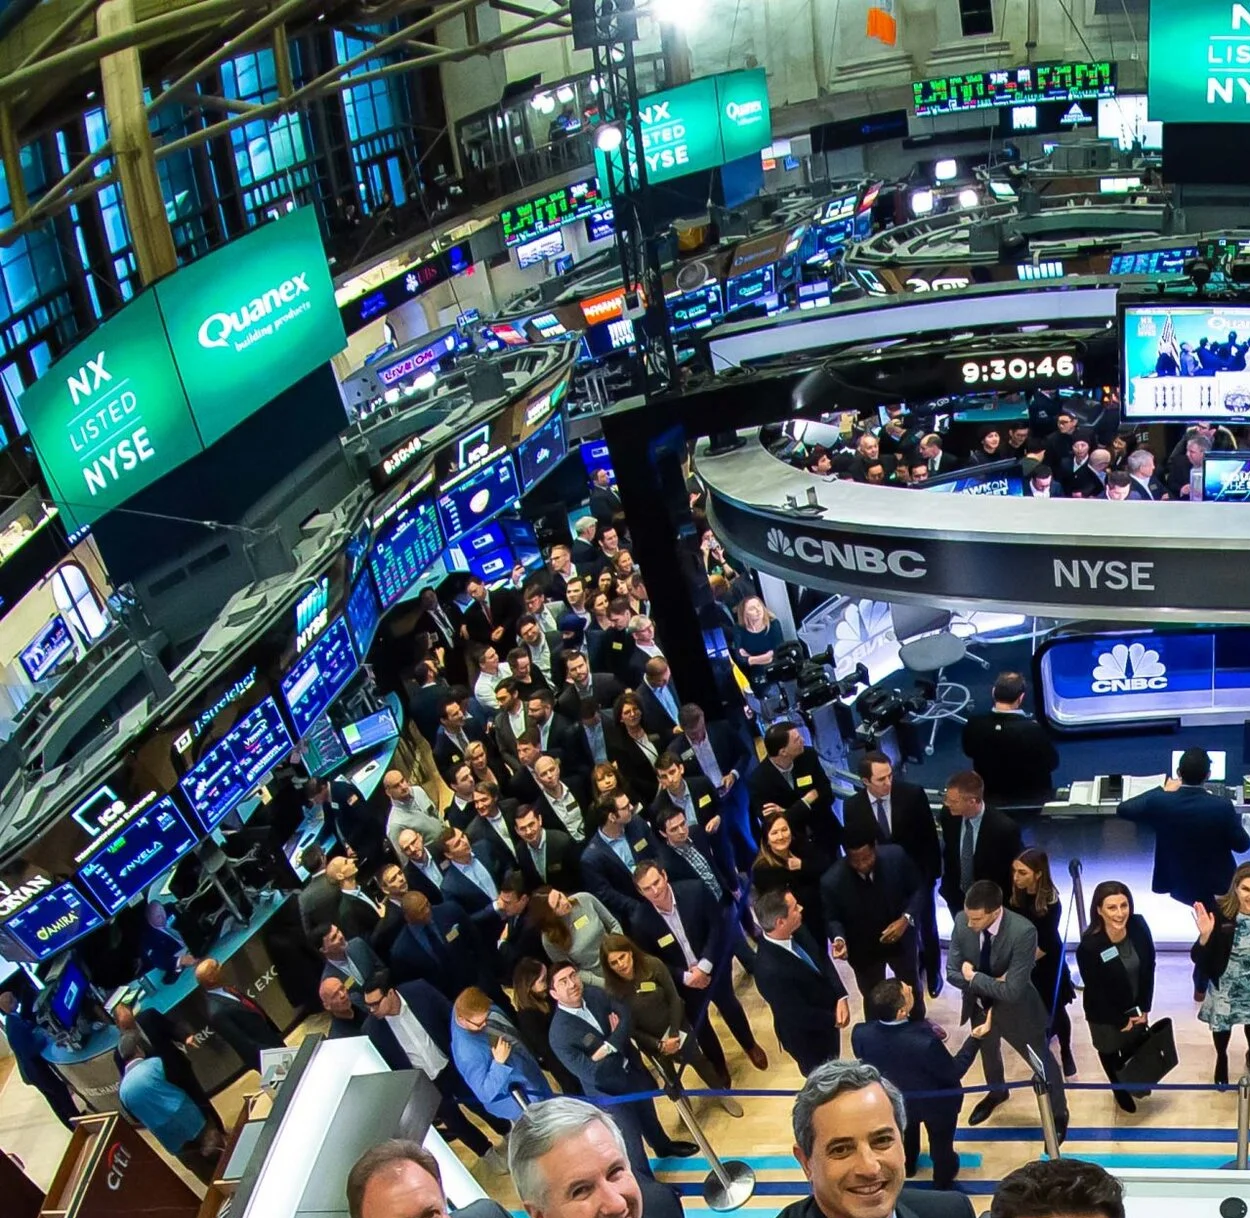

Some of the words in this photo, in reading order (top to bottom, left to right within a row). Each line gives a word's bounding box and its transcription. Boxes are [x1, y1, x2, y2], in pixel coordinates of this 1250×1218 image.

[198, 272, 310, 349] Quanex
[235, 323, 273, 351] building
[274, 301, 311, 331] products
[67, 351, 112, 406] NX
[962, 355, 1075, 383] 9:30:46
[70, 391, 137, 452] LISTED
[82, 426, 155, 496] NYSE
[793, 535, 928, 579] CNBC
[1053, 559, 1156, 592] NYSE
[296, 607, 329, 653] NYSE
[1091, 676, 1168, 694] CNBC
